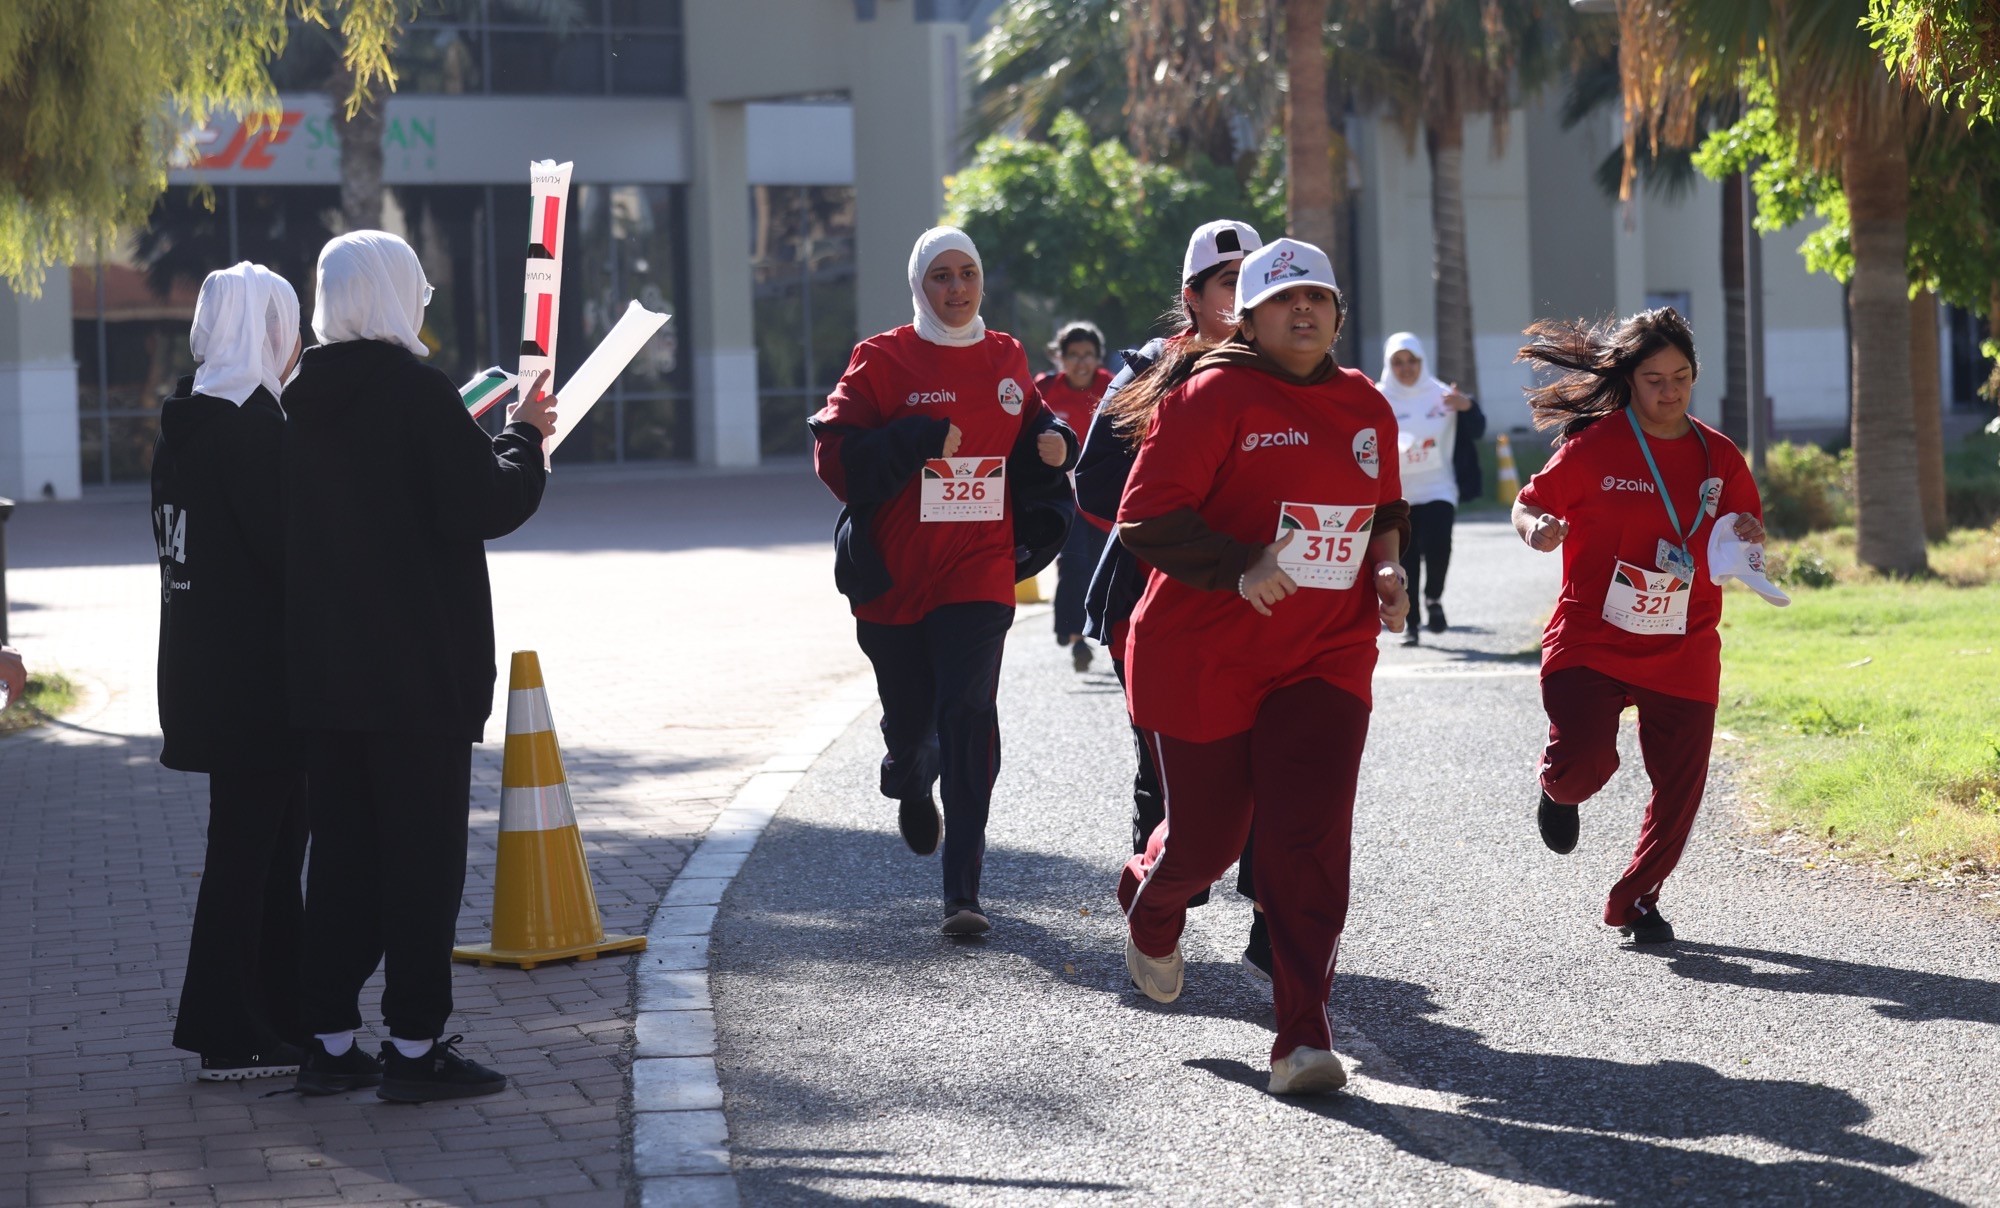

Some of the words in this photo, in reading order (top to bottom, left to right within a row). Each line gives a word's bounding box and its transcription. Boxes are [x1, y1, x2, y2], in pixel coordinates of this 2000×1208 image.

[920, 389, 956, 403] zain
[1260, 428, 1309, 447] zain
[942, 481, 985, 501] 326
[1616, 478, 1654, 493] zain
[1303, 535, 1353, 562] 315
[1631, 593, 1671, 615] 321
